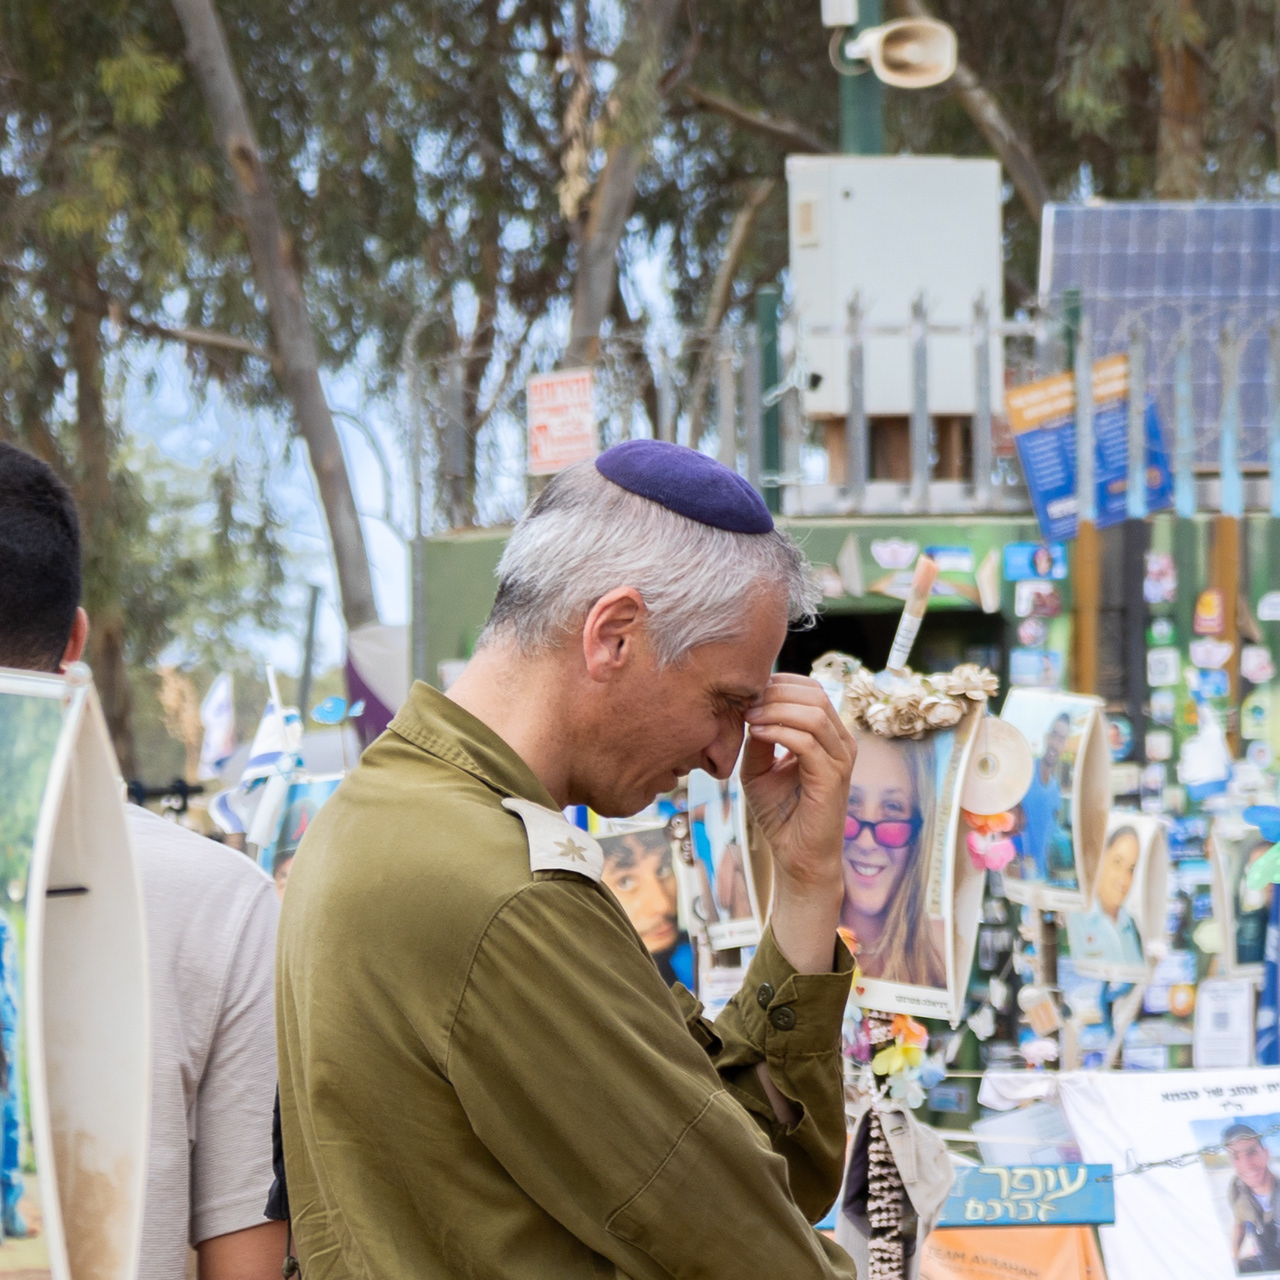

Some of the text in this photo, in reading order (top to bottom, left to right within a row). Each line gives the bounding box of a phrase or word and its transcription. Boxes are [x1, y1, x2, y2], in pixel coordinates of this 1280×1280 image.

[1161, 1089, 1200, 1102] סבתא
[1203, 1087, 1224, 1098] של
[1228, 1084, 1258, 1097] אהוב
[927, 1244, 967, 1262] TEAM
[971, 1254, 1039, 1278] AVRAHAM
